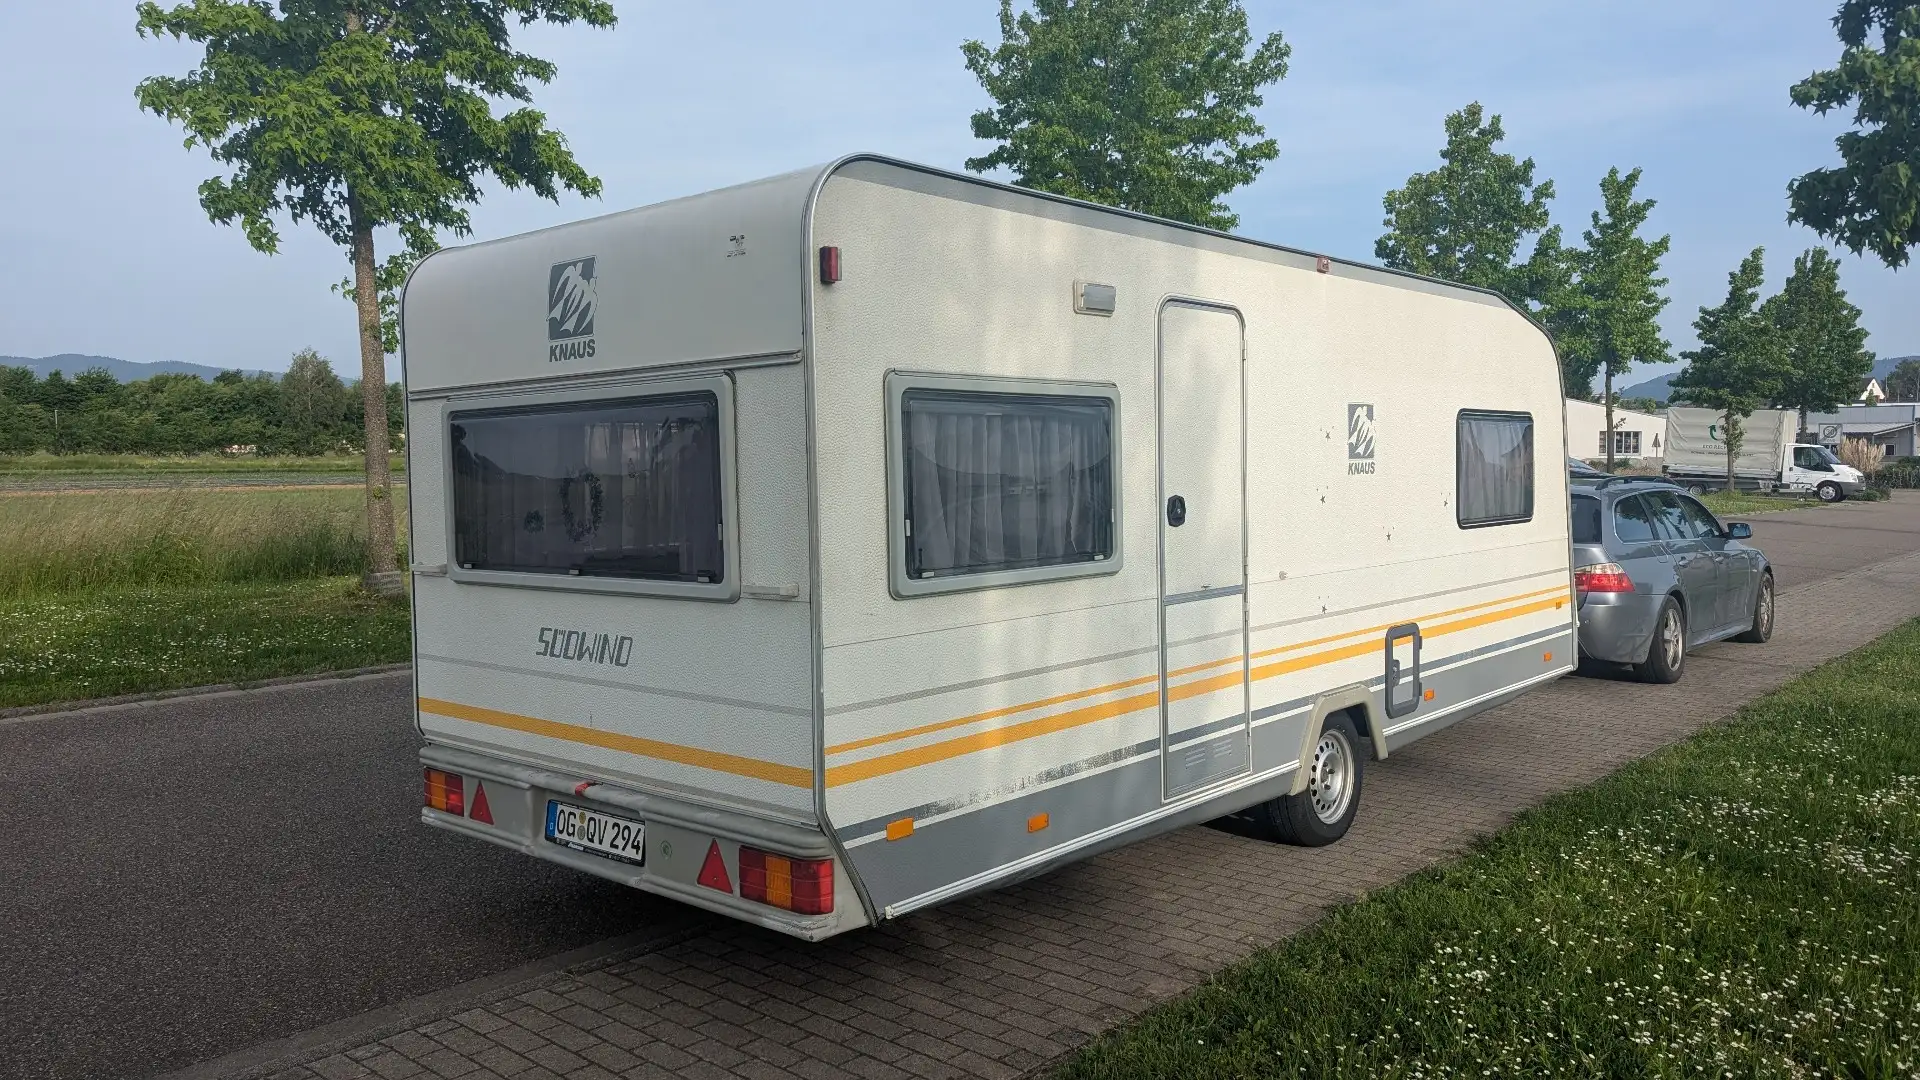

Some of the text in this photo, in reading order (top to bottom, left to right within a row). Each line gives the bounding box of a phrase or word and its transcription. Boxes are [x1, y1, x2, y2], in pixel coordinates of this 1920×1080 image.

[549, 338, 596, 362] KNAUS
[1348, 461, 1376, 475] KNAUS
[535, 627, 633, 668] SÜDWIND
[556, 808, 577, 838] OG
[586, 816, 608, 845] QV
[609, 822, 642, 855] 294
